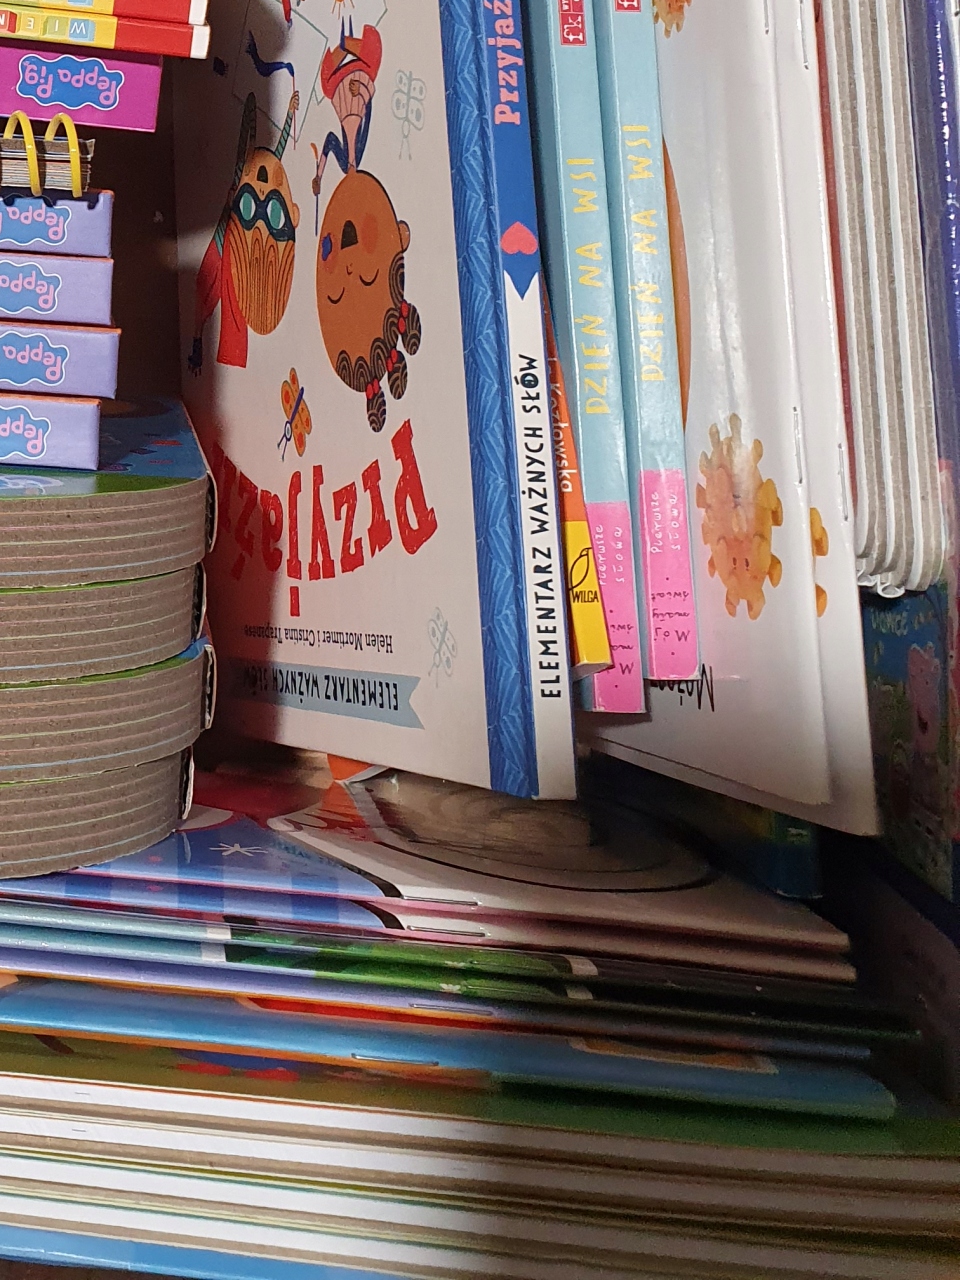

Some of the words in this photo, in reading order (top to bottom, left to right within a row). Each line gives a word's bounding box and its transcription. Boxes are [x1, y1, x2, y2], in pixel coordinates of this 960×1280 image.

[23, 65, 54, 98] Pig
[57, 65, 118, 105] Peppa
[622, 125, 654, 179] WSI
[567, 158, 598, 213] WSI
[8, 202, 67, 240] Peppa
[631, 209, 658, 255] NA
[576, 242, 603, 287] NA
[629, 282, 665, 381] DZIEŃ
[2, 344, 62, 382] Peppa
[575, 315, 610, 414] DZIEŃ
[512, 354, 542, 414] SŁÓW
[519, 427, 556, 535] WAŻNYCH
[649, 491, 662, 554] Pierwsze
[669, 493, 682, 551] słowa
[612, 526, 626, 582] słowa
[571, 590, 599, 604] WILGA
[650, 589, 690, 602] świat
[242, 622, 283, 643] Trapanese
[283, 628, 316, 647] Cristina
[322, 629, 363, 651] Mortimer
[365, 633, 394, 652] Helen
[530, 548, 562, 698] ELEMENTARZ
[610, 623, 634, 635] świ
[653, 626, 691, 642] Mój
[271, 667, 321, 703] WAŻNYCH
[323, 675, 399, 711] ELEMENTARZ
